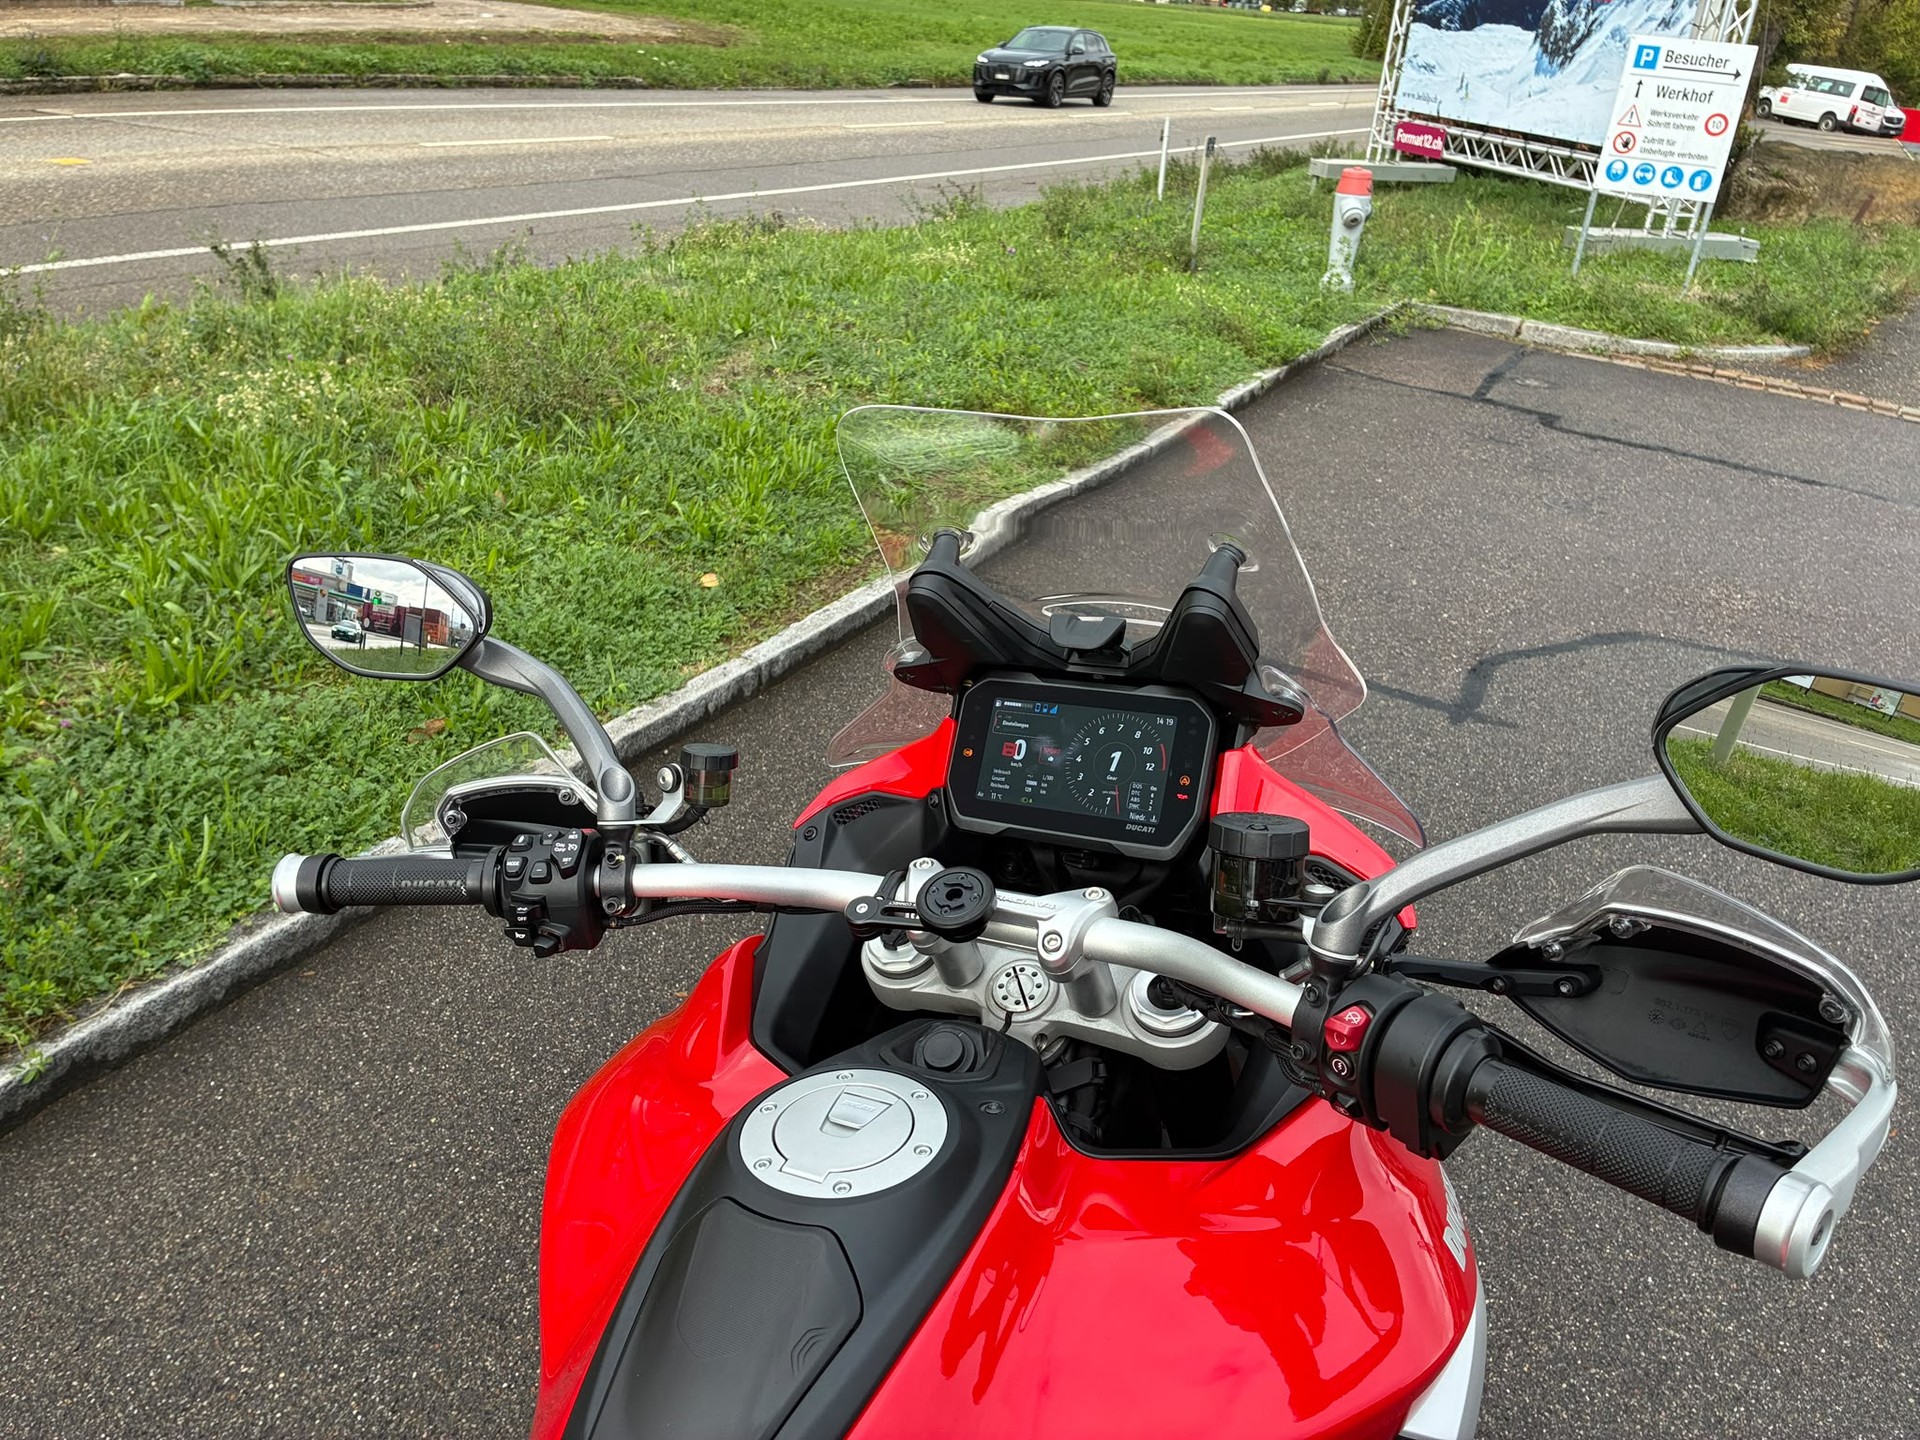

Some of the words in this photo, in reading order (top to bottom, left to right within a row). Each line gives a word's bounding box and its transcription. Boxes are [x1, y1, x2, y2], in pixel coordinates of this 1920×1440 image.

[1664, 50, 1730, 69] Besucher
[1656, 85, 1714, 104] Werkhof
[1672, 122, 1696, 131] fahren
[1712, 120, 1722, 129] 10
[1396, 128, 1444, 151] Format12.ch
[1014, 739, 1026, 760] 0
[1110, 751, 1122, 772] 1
[1126, 824, 1156, 834] DUCATI
